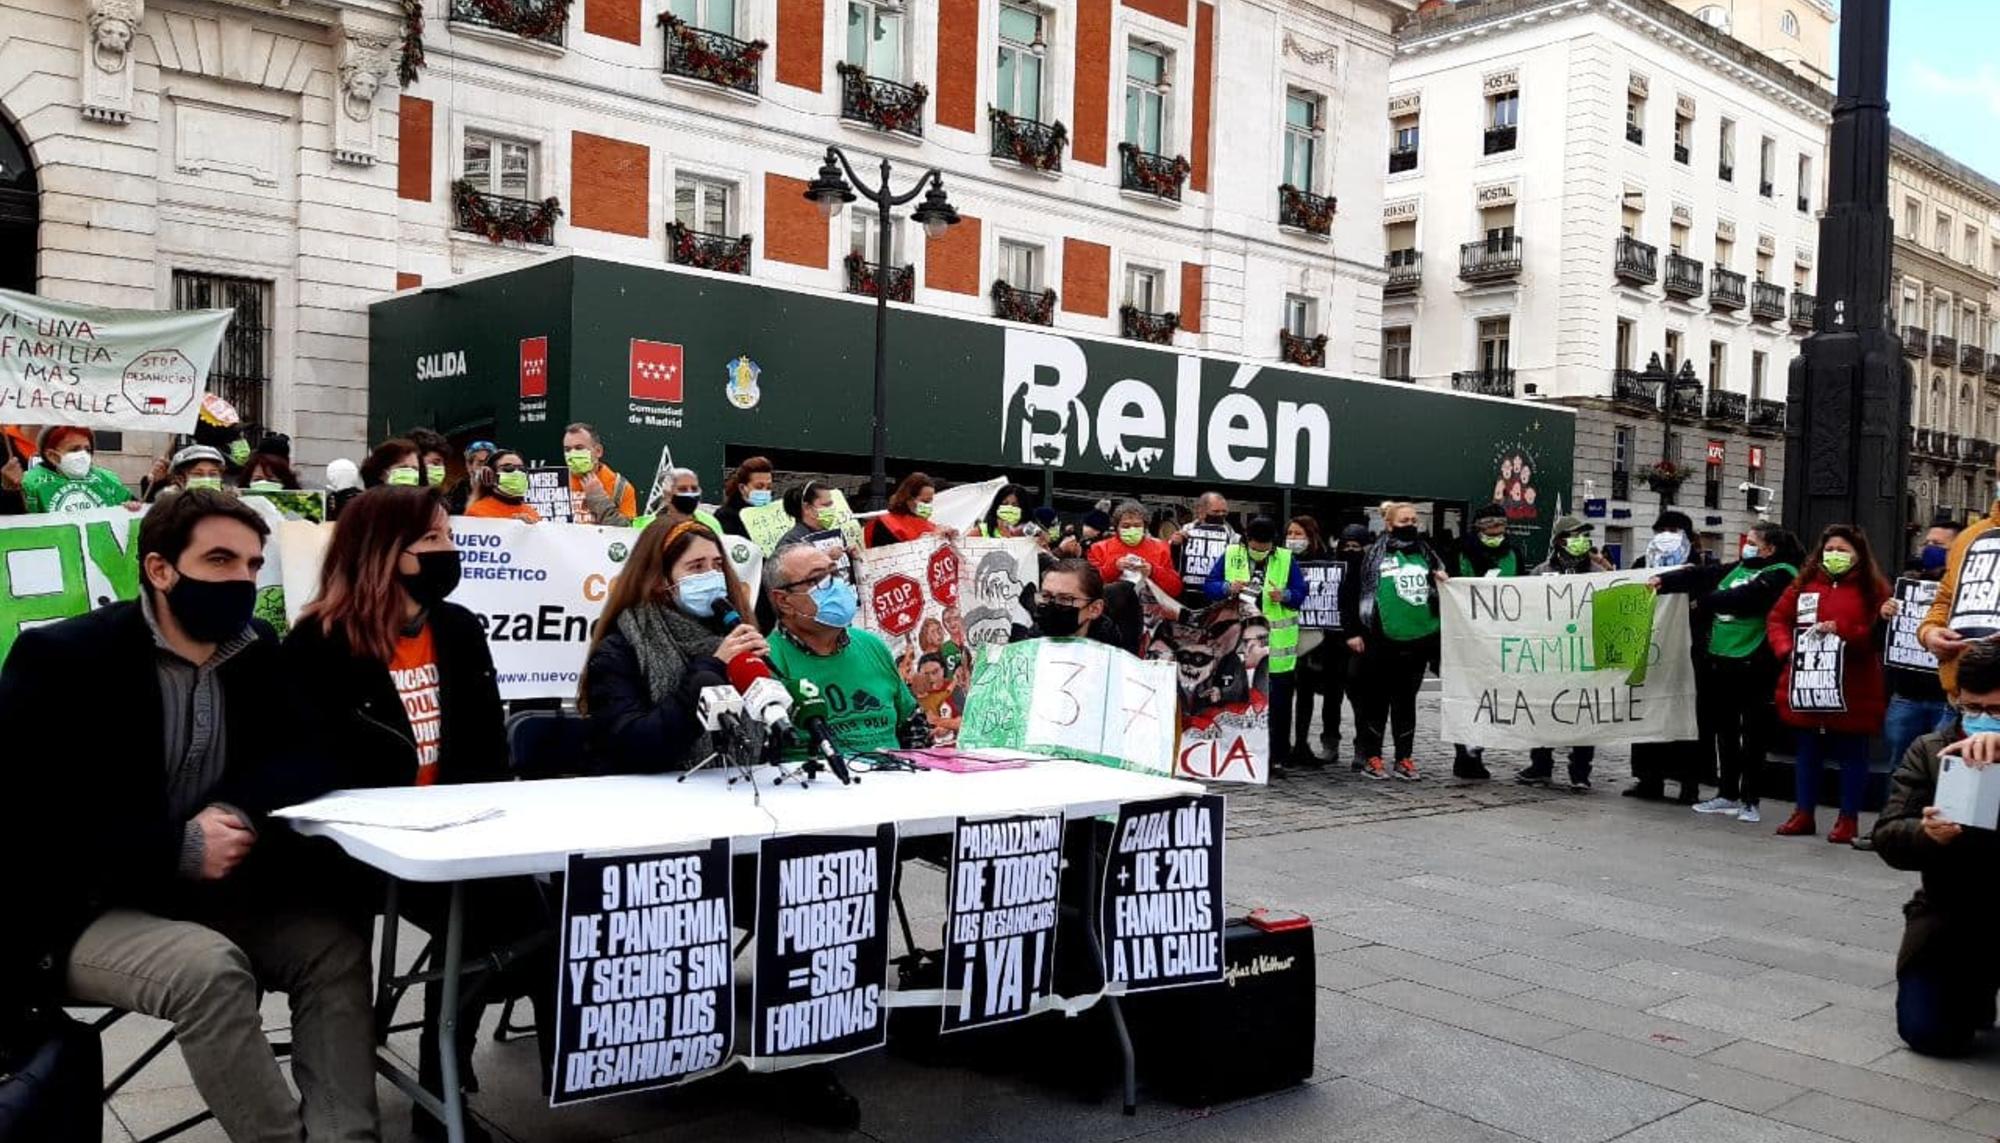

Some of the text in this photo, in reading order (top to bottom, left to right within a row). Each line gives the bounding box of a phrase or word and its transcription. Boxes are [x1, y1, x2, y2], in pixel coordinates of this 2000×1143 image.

[1479, 186, 1513, 201] HOSTAL
[24, 363, 80, 386] MAS
[142, 357, 177, 367] STOP
[416, 350, 467, 381] SALIDA
[629, 403, 682, 416] Comunidad
[629, 415, 682, 428] de Madrid
[1001, 329, 1331, 488] Belén
[455, 534, 502, 548] UEVO
[459, 550, 511, 564] ODELO
[463, 566, 547, 581] ERGÉTICO
[1400, 574, 1427, 588] STO
[876, 582, 912, 611] STOP
[1471, 584, 1521, 622] NO
[1817, 653, 1836, 670] 200
[1049, 661, 1087, 727] 3
[1121, 676, 1158, 735] 7
[1474, 683, 1645, 726] ALA CALLE
[1119, 800, 1213, 853] CADA DÍA
[602, 855, 702, 911] 9 MESES
[779, 847, 878, 907] NUESTRA
[956, 851, 1058, 913] DE TODOS
[1116, 848, 1209, 894] + DE 200
[569, 898, 728, 960] DE PANDEMIA
[776, 893, 876, 956] POBREZA
[954, 900, 1056, 945] LOS DESAHUCIOS
[1115, 890, 1212, 938] FAMILIAS
[570, 942, 728, 1005] Y SEGUÍS SIN
[1113, 931, 1219, 984] A LA CALLE
[579, 990, 717, 1049] PARAR LOS
[766, 983, 879, 1055] FORTUNAS
[564, 1032, 724, 1094] DESAHUCIOS
